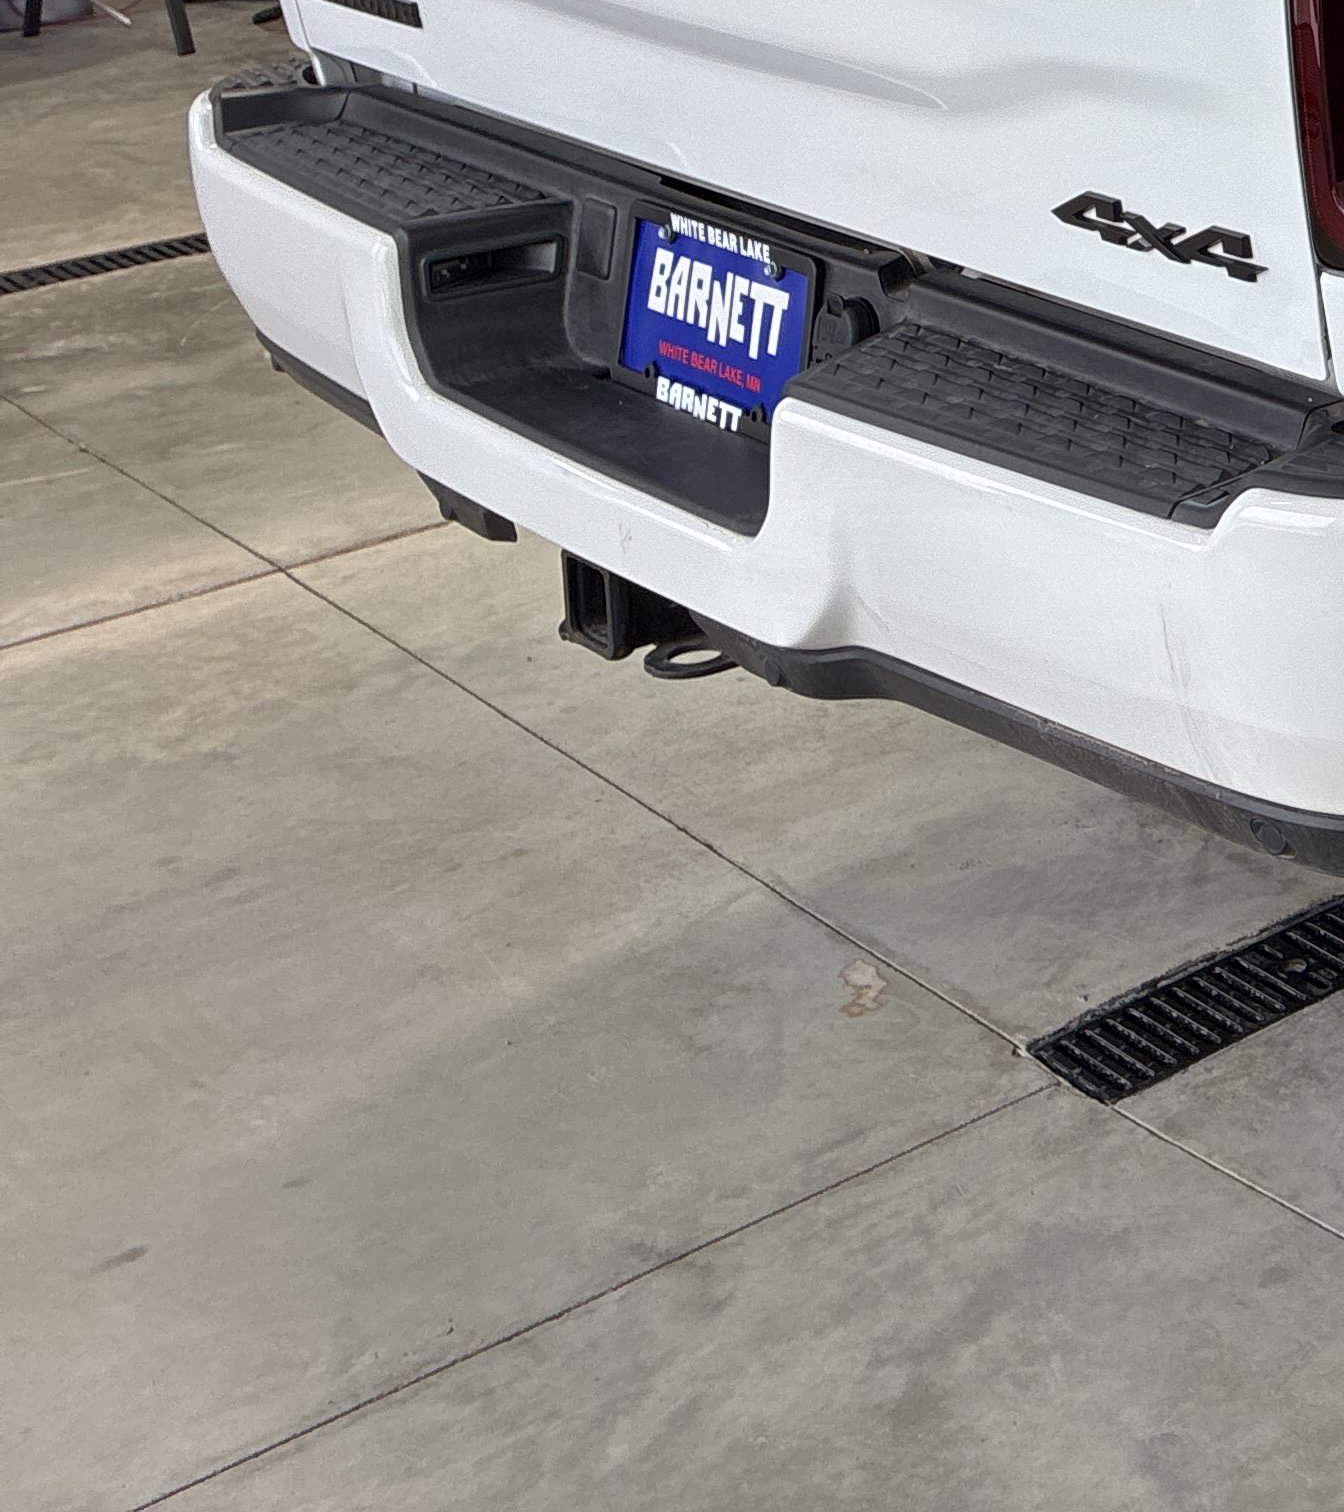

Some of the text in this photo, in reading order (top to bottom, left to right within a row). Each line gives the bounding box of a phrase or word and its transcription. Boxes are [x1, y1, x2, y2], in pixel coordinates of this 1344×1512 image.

[670, 212, 771, 264] WHITE BEAR LAKE
[647, 246, 790, 361] BARNETT
[658, 339, 689, 365] WHITE
[690, 349, 718, 373] BEAR
[719, 358, 747, 388] LAKE,
[656, 375, 743, 433] BARNETT
